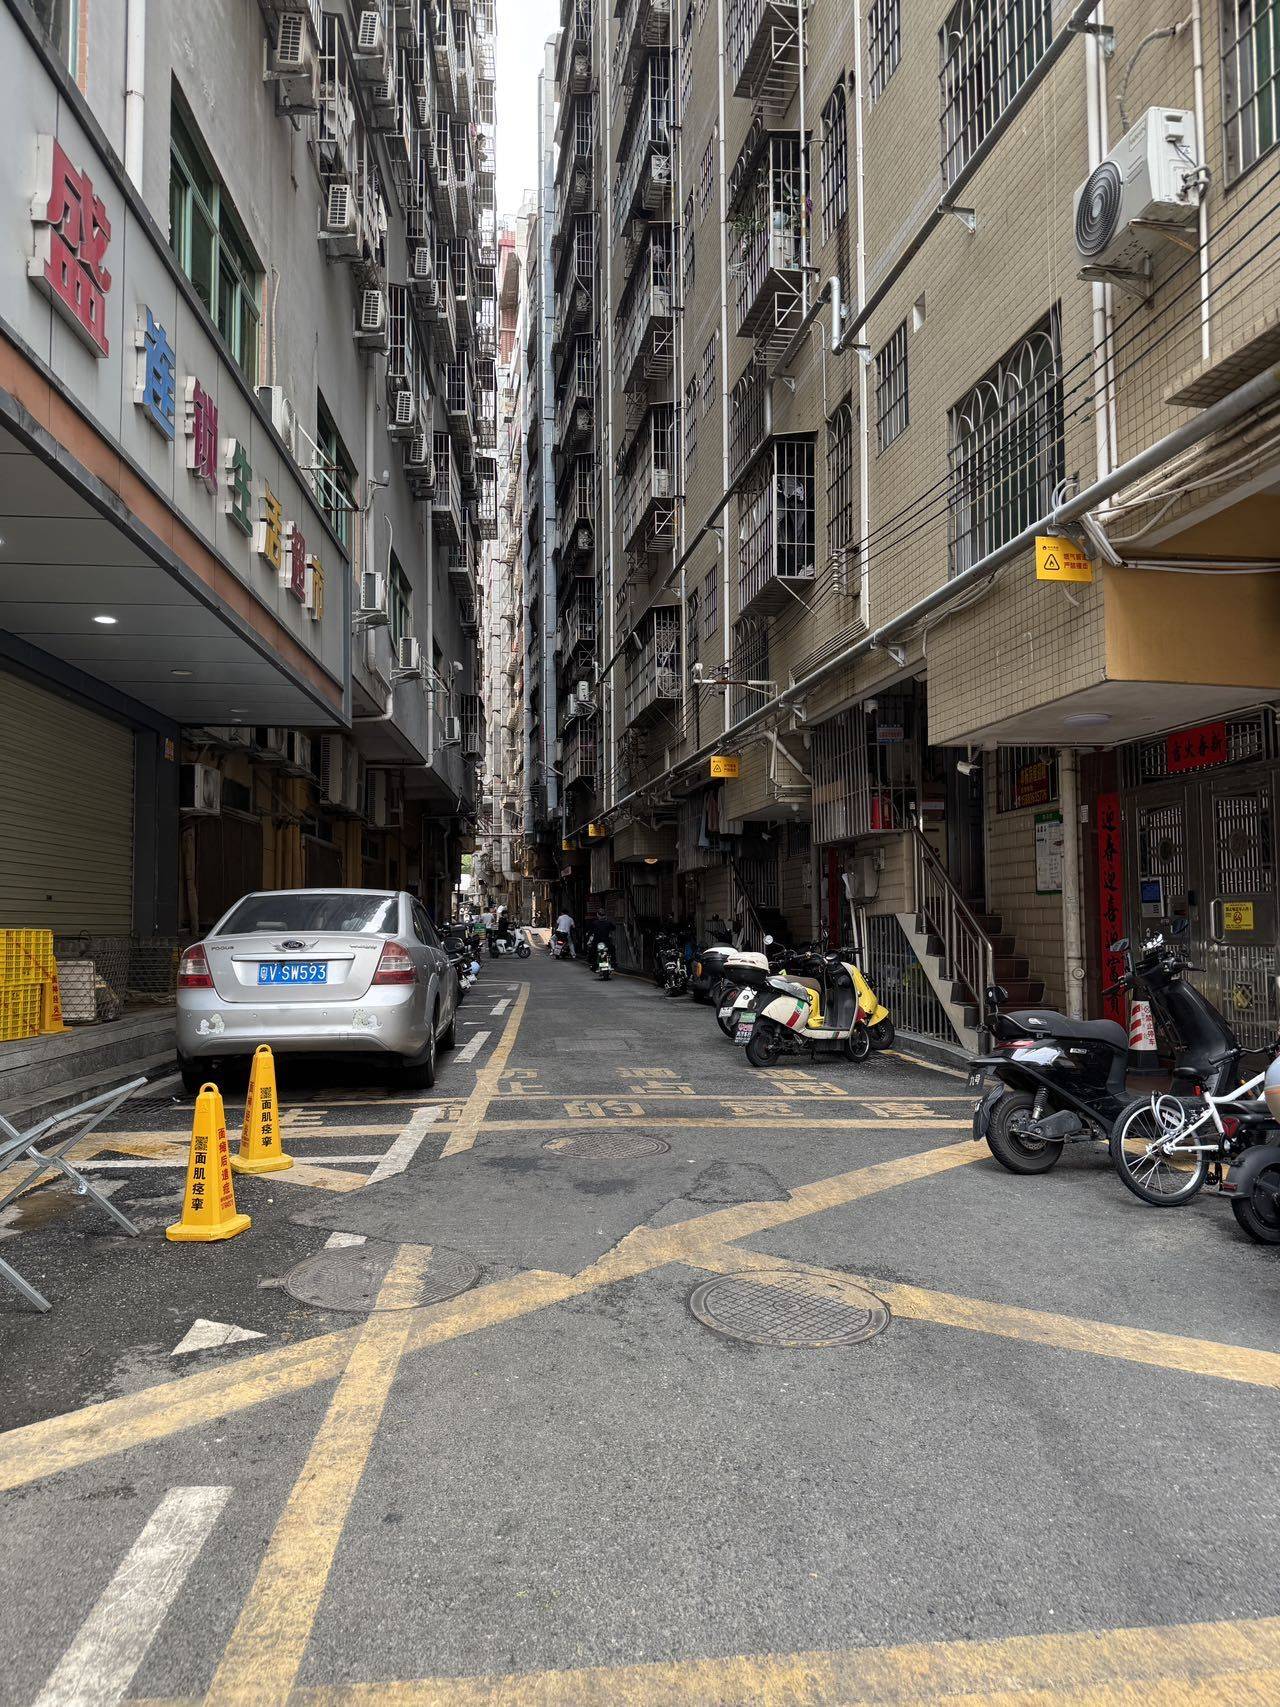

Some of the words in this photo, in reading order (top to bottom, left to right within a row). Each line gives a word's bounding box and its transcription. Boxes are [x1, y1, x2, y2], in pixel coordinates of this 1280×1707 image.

[261, 1099, 273, 1147] 面肌痉挛
[191, 1152, 208, 1211] 面肌痉挛
